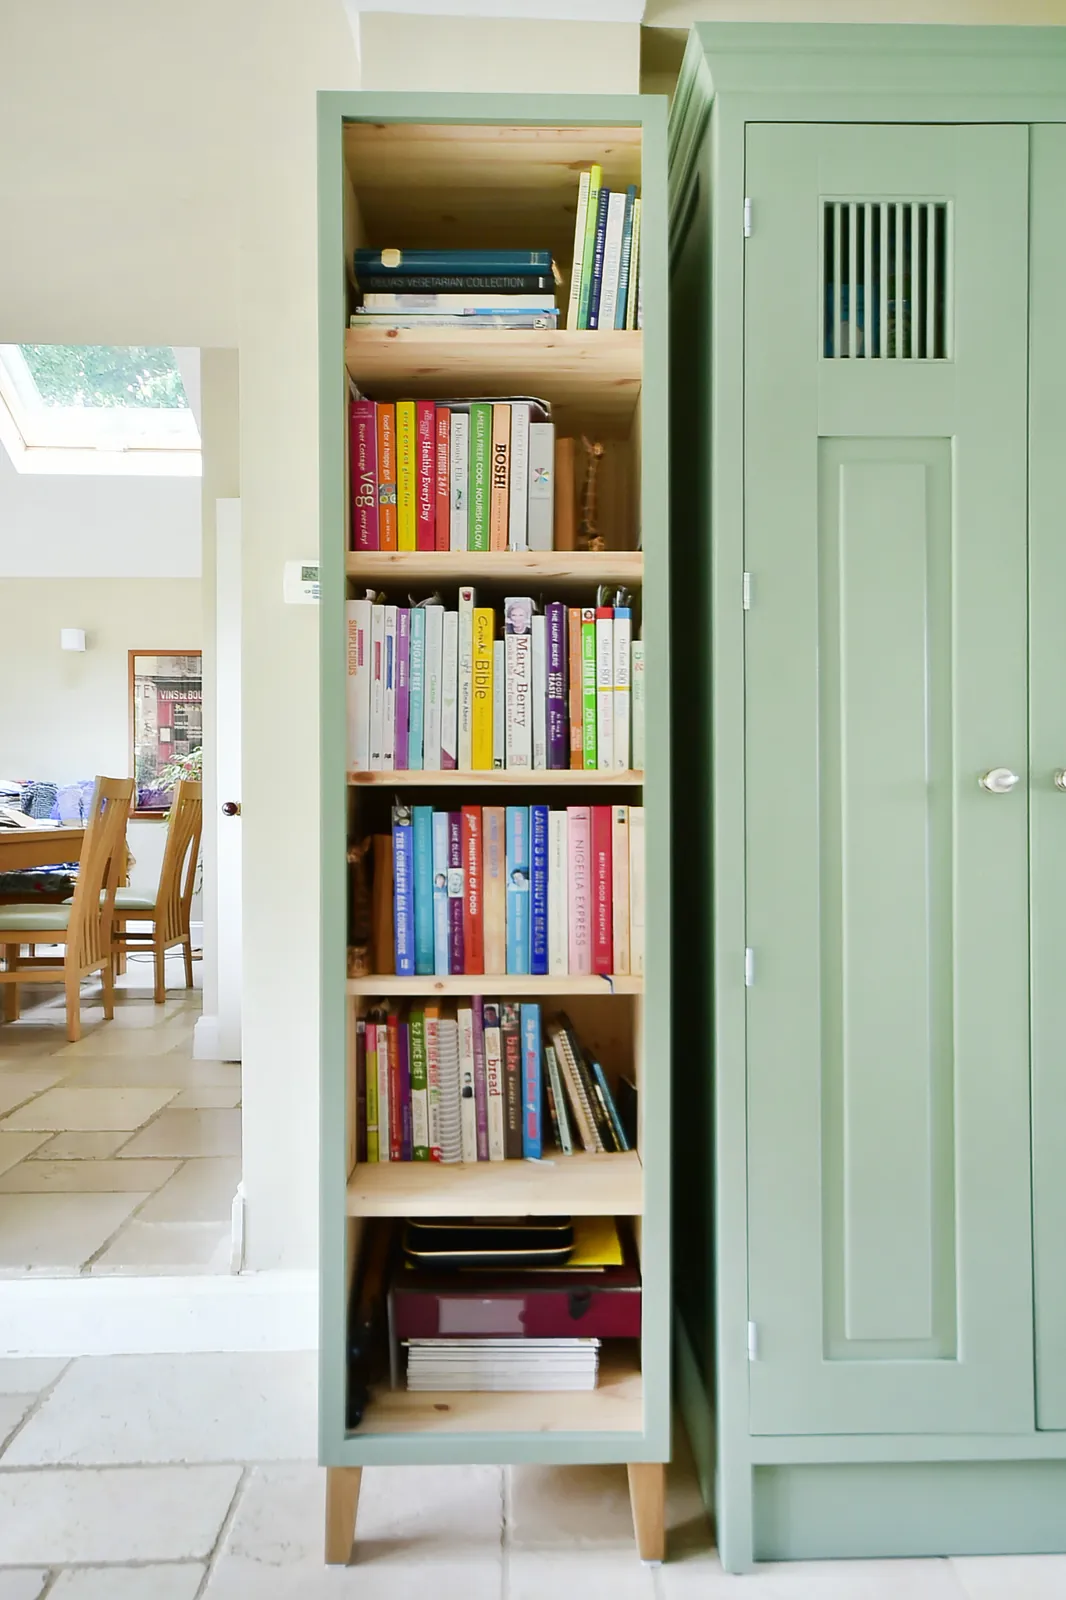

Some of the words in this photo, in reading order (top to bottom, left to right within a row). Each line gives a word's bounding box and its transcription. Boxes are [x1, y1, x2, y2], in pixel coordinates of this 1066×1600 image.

[406, 276, 464, 288] VEGETARIAN
[466, 276, 524, 288] COLLECTION
[477, 410, 485, 439] AMELIA
[358, 443, 367, 471] Cottage
[382, 448, 391, 468] happy
[453, 422, 463, 465] Deliciously
[476, 440, 484, 461] FREER
[420, 441, 433, 476] Healthy
[438, 443, 447, 474] SUPERFOODS
[494, 444, 507, 489] BOSH!
[437, 476, 447, 496] 24/7
[455, 467, 463, 482] Ella
[420, 477, 430, 502] Every
[420, 503, 430, 521] Day
[349, 620, 357, 676] SIMPLICIOUS
[412, 639, 422, 669] SUGAR
[514, 638, 528, 678] Mary
[412, 671, 421, 691] FREE
[475, 660, 490, 699] Bible
[600, 668, 610, 685] 800
[616, 668, 627, 684] 800
[160, 690, 178, 700] VINS
[514, 682, 528, 728] Berry
[535, 810, 544, 854] JAMIE'S
[396, 850, 405, 893] COMPLETE
[575, 839, 585, 890] NIGELLA
[469, 878, 476, 888] OF
[535, 916, 544, 954] MEALS
[575, 896, 585, 946] EXPRESS
[412, 1022, 420, 1034] 5:2
[412, 1036, 422, 1059] JUICE
[506, 1035, 519, 1072] bake
[414, 1062, 422, 1080] DIET
[488, 1058, 503, 1096] bread
